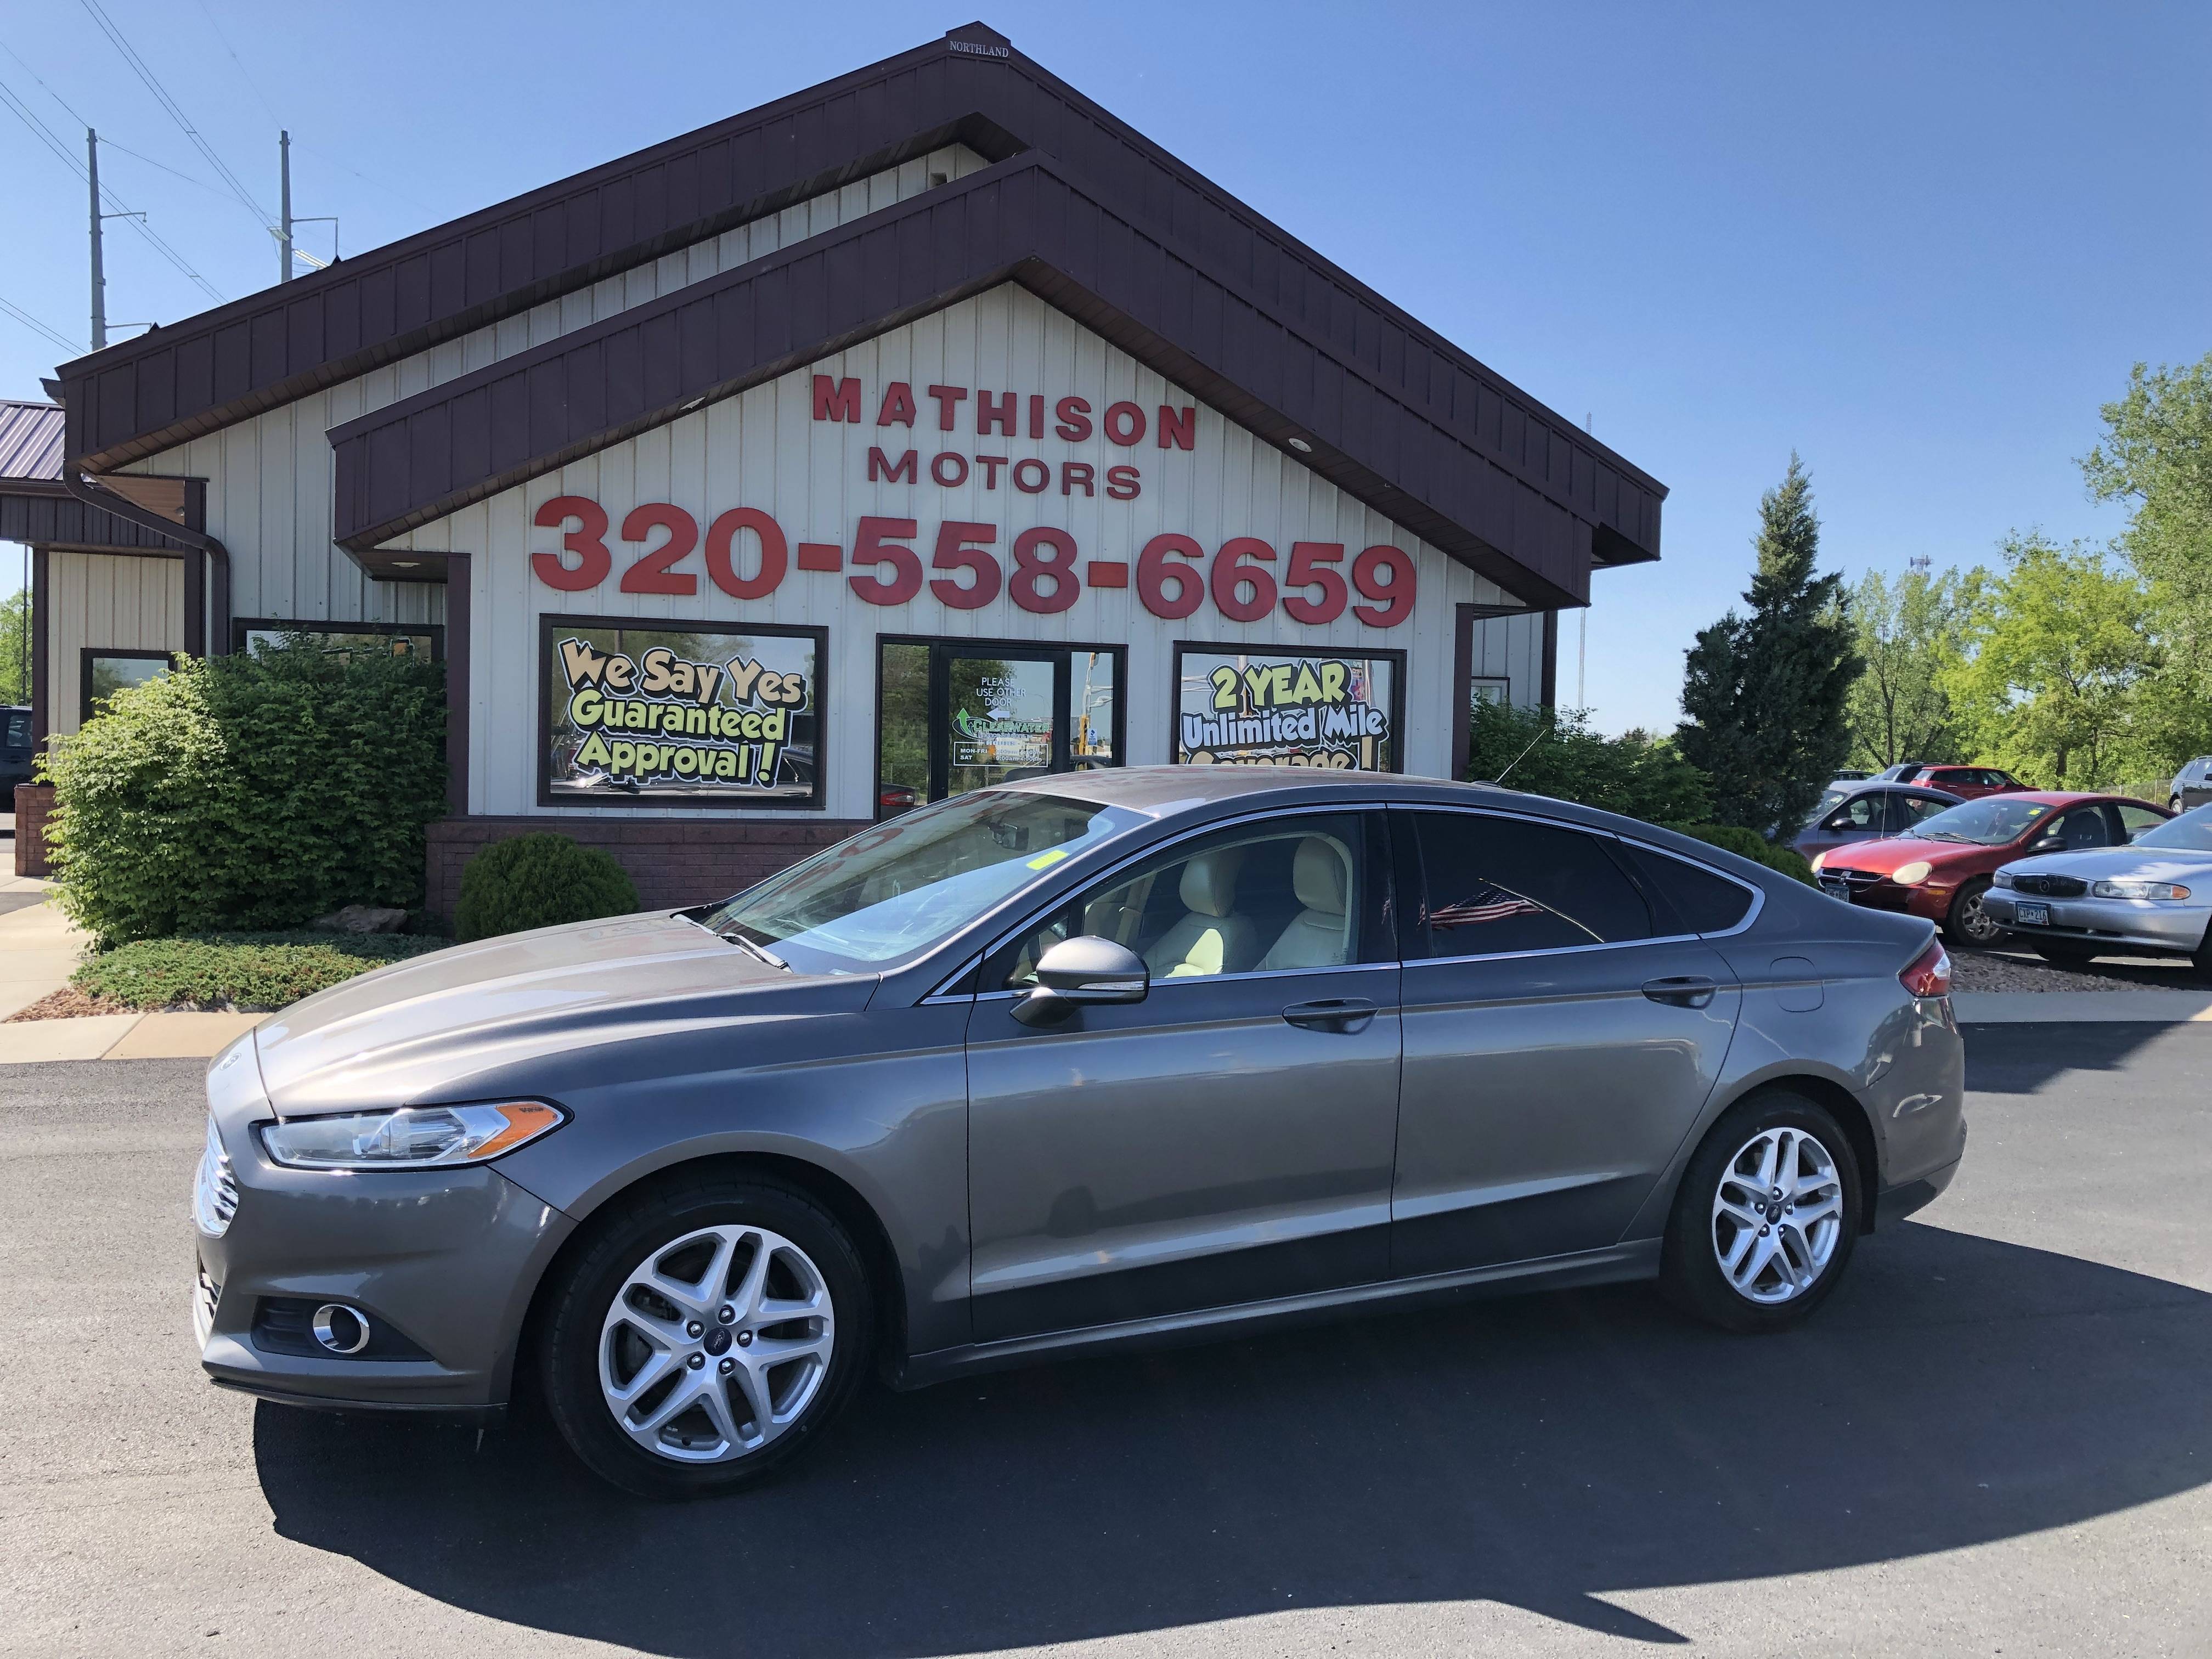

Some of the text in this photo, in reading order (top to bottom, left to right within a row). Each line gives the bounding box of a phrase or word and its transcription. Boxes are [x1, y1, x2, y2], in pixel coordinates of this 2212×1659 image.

[950, 41, 1009, 58] NORTHLAND
[814, 375, 1195, 450] MATHISON
[868, 447, 1141, 500] MOTORS
[532, 495, 1417, 628] 320-558-6659
[561, 641, 802, 704] We Say Yes
[977, 688, 1026, 697] USE OTHER
[981, 678, 1014, 686] PLEASE
[1212, 667, 1238, 709] 2
[1244, 662, 1347, 706] YEAR
[571, 689, 786, 741] Guaranteed
[985, 698, 1012, 707] DOOR
[1182, 703, 1384, 748] Unlimited Mile
